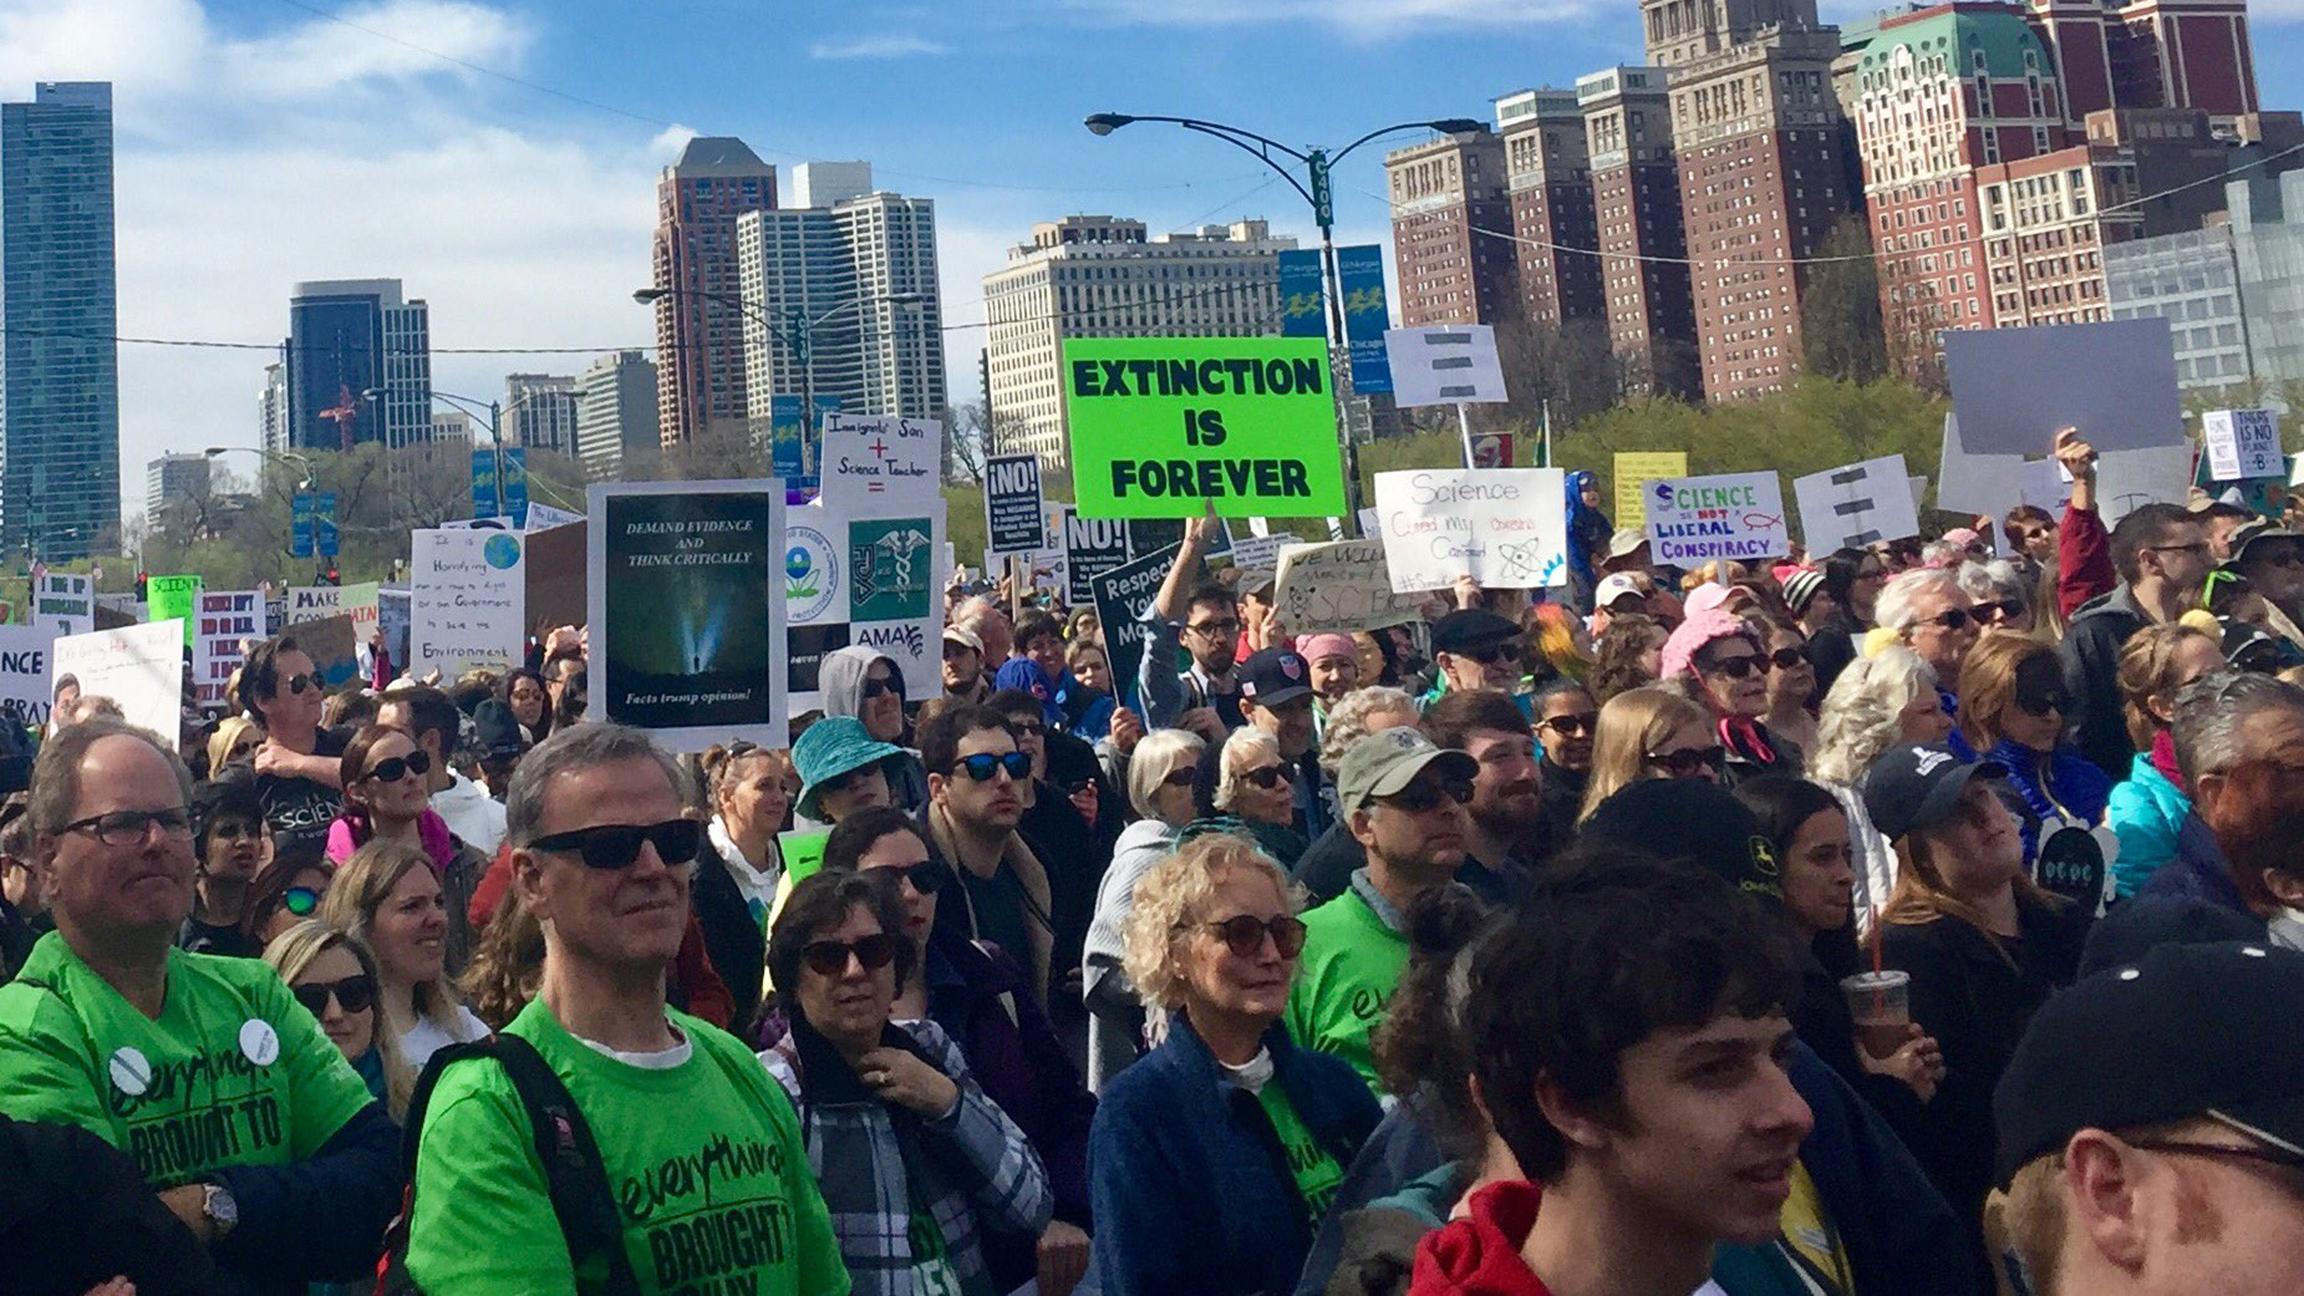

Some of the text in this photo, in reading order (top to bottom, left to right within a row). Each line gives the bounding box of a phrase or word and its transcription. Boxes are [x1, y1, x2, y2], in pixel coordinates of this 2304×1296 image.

[1073, 358, 1322, 396] EXTINCTION
[898, 419, 924, 438] Son
[1184, 409, 1227, 446] IS
[2241, 424, 2272, 441] IS NO
[838, 457, 928, 477] Science Teacher
[2255, 453, 2266, 470] B
[990, 461, 1036, 495] ¡NO!
[1111, 459, 1311, 497] FOREVER
[1411, 473, 1520, 505] Science
[1656, 484, 1757, 511] SCIENCE
[1697, 510, 1728, 520] NOT
[626, 520, 753, 535] DEMAND EVIDENCE
[1068, 516, 1123, 550] NO!
[1656, 521, 1735, 538] LIBERAL
[676, 538, 704, 549] AND
[1661, 540, 1770, 559] CONSPIRACY
[629, 552, 752, 567] THINK CRITICALLY
[1105, 556, 1175, 600] Respect
[296, 592, 339, 608] MAKE
[423, 642, 508, 658] Environment
[1, 651, 43, 674] NCE
[626, 688, 751, 705] Facts trump opinion!
[279, 794, 348, 829] SCIEN
[238, 1095, 282, 1150] TO
[648, 1203, 785, 1290] BROUGHT
